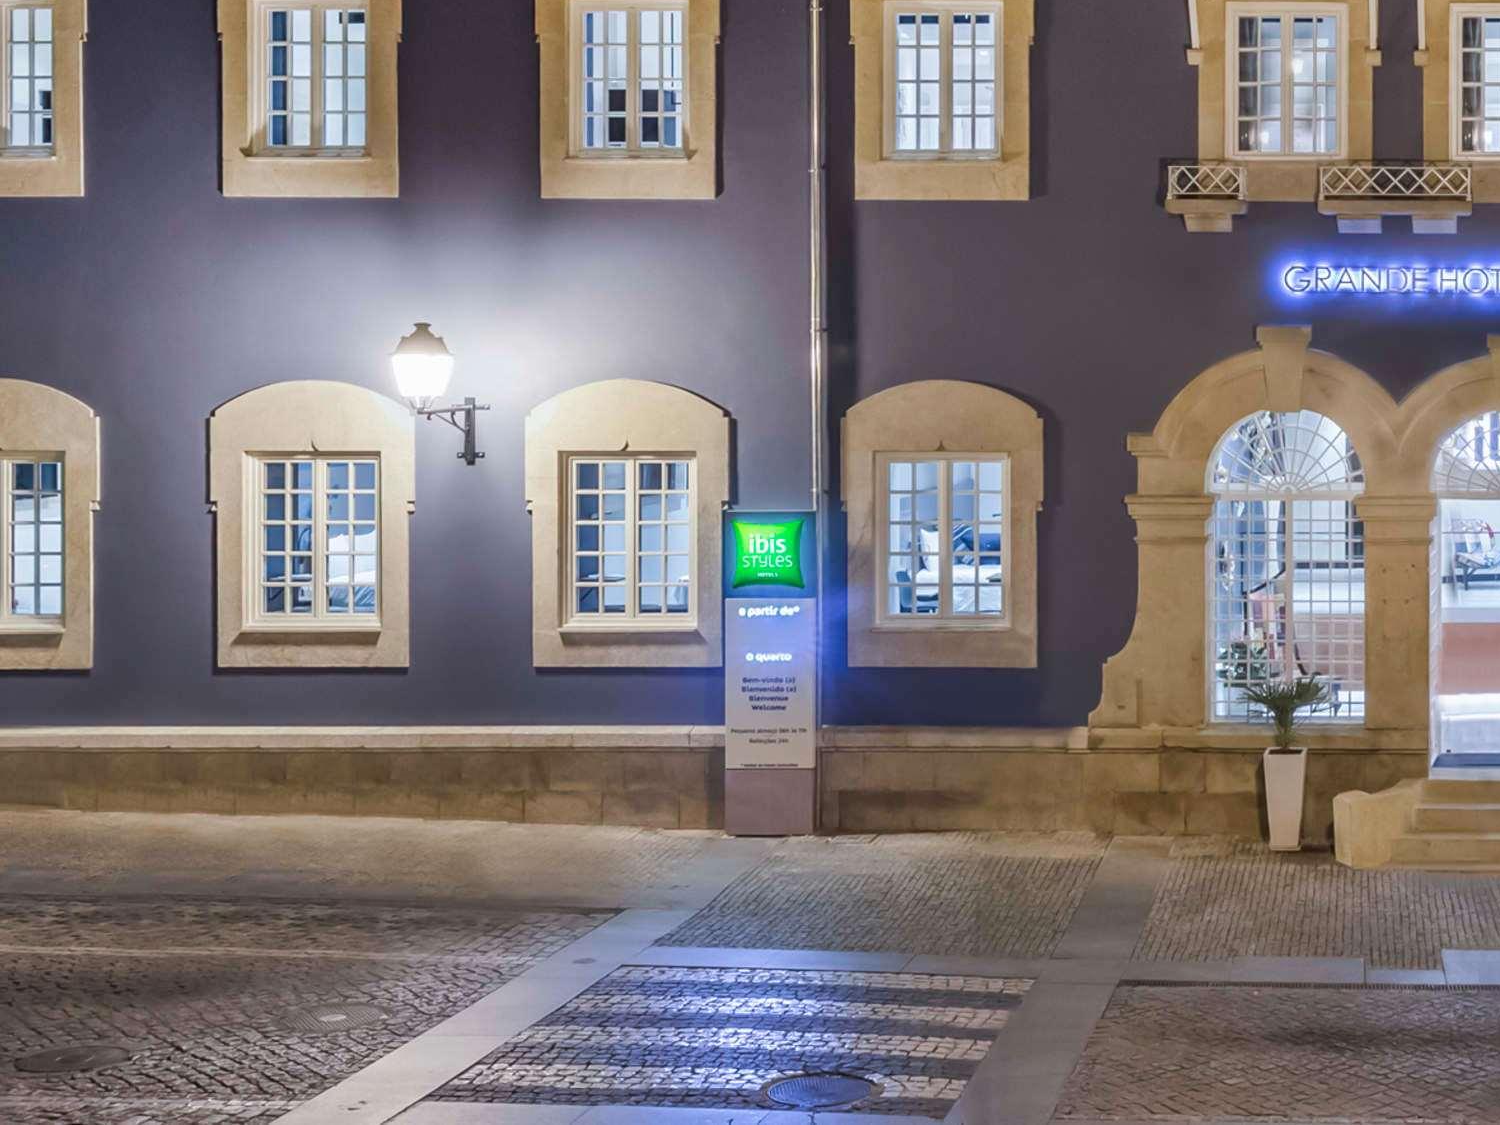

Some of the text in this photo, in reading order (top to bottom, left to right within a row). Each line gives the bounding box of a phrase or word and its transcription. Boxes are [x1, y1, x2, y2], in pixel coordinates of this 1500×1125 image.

[1284, 265, 1428, 294] GRANDE
[748, 532, 787, 554] ibis
[747, 605, 778, 618] partir
